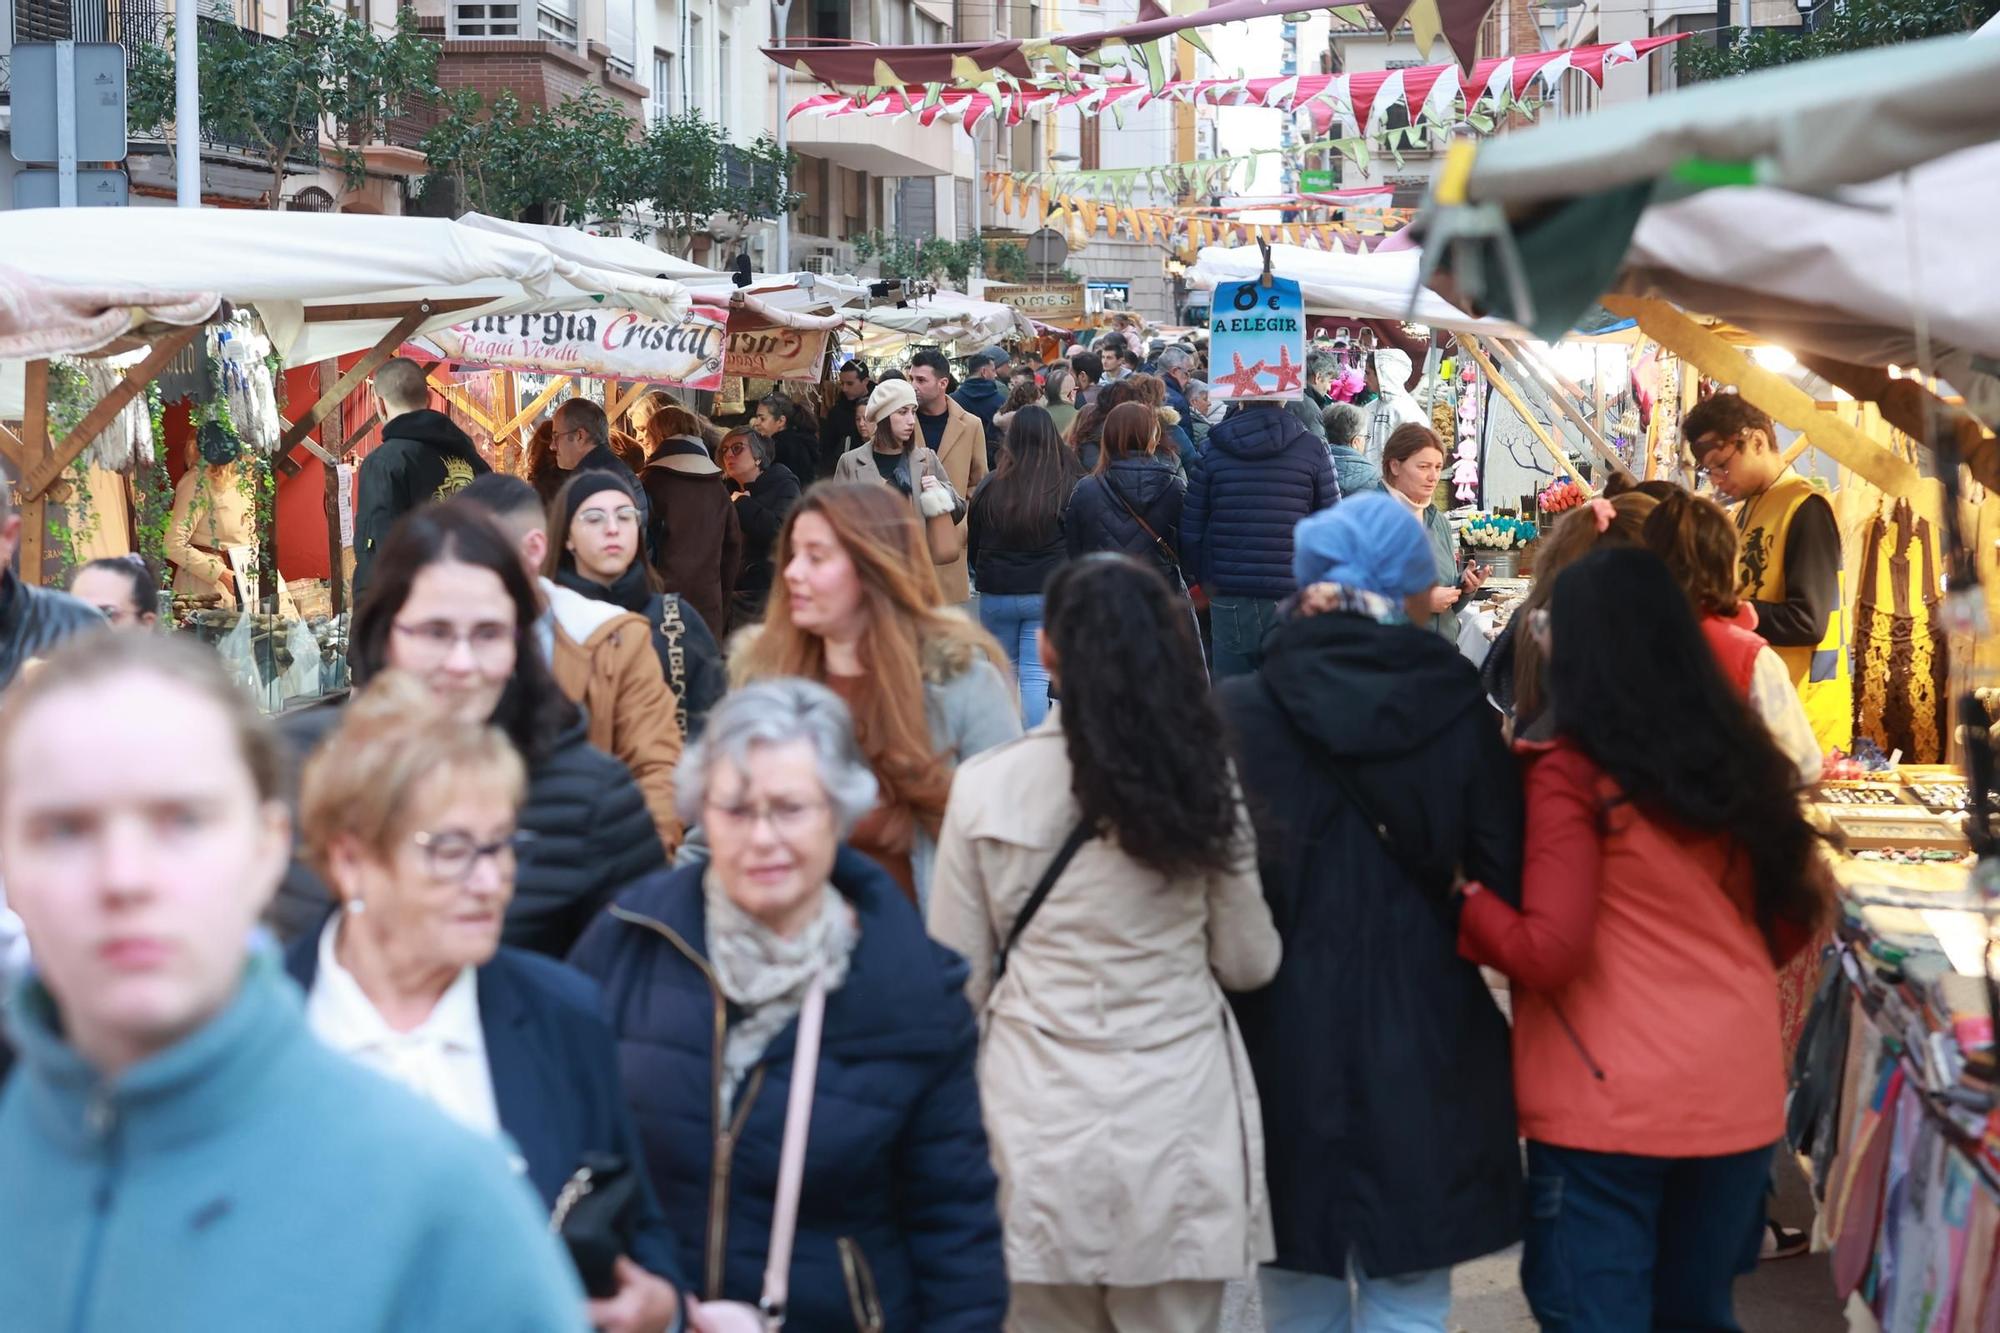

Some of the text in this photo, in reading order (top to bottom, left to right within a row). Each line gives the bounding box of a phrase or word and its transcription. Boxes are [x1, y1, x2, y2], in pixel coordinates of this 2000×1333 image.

[1267, 295, 1280, 311] €
[1214, 318, 1297, 333] A ELEGIR
[448, 311, 716, 361] nergia Cristal
